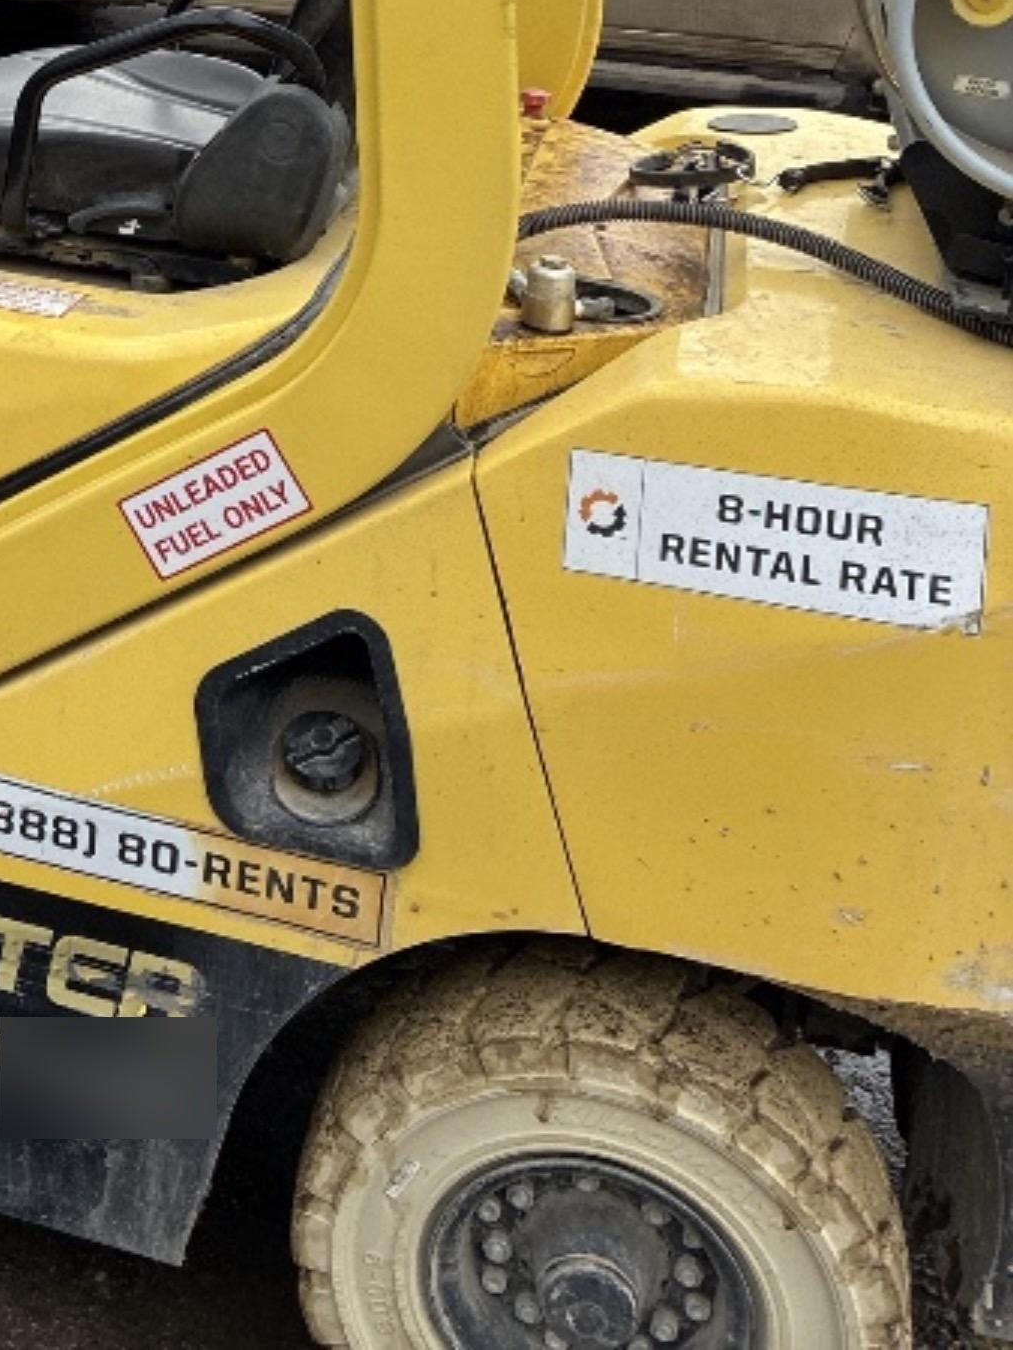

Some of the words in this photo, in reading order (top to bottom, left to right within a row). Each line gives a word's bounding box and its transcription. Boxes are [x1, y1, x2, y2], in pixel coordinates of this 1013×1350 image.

[134, 449, 271, 529] UNLEADED
[152, 518, 223, 564] FUEL
[223, 479, 290, 529] ONLY
[717, 493, 884, 547] 8-HOUR
[659, 532, 822, 586] RENTAL
[839, 561, 953, 607] RATE
[117, 832, 361, 920] 80-RENTS
